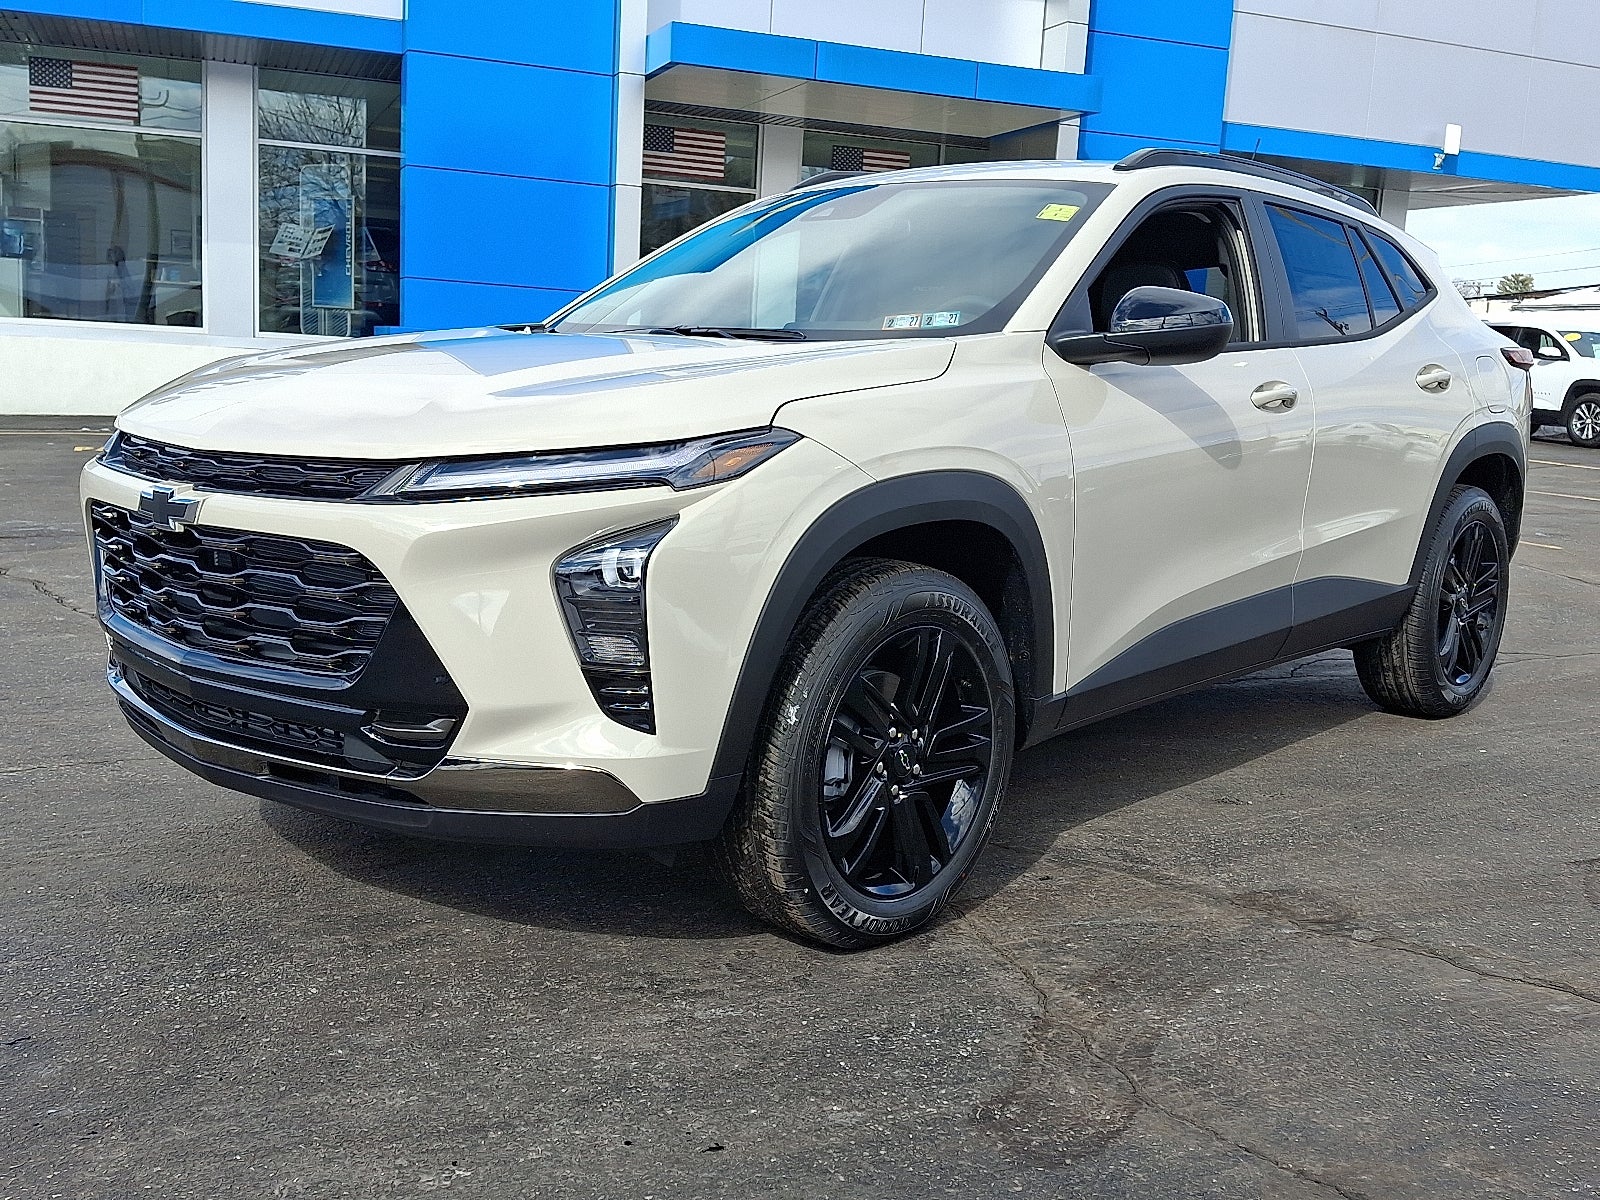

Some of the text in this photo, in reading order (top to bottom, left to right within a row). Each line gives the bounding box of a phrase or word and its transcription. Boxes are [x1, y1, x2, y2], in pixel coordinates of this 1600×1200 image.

[887, 318, 895, 328] 2
[909, 316, 919, 327] 27
[925, 316, 933, 326] 2
[948, 313, 958, 324] 27
